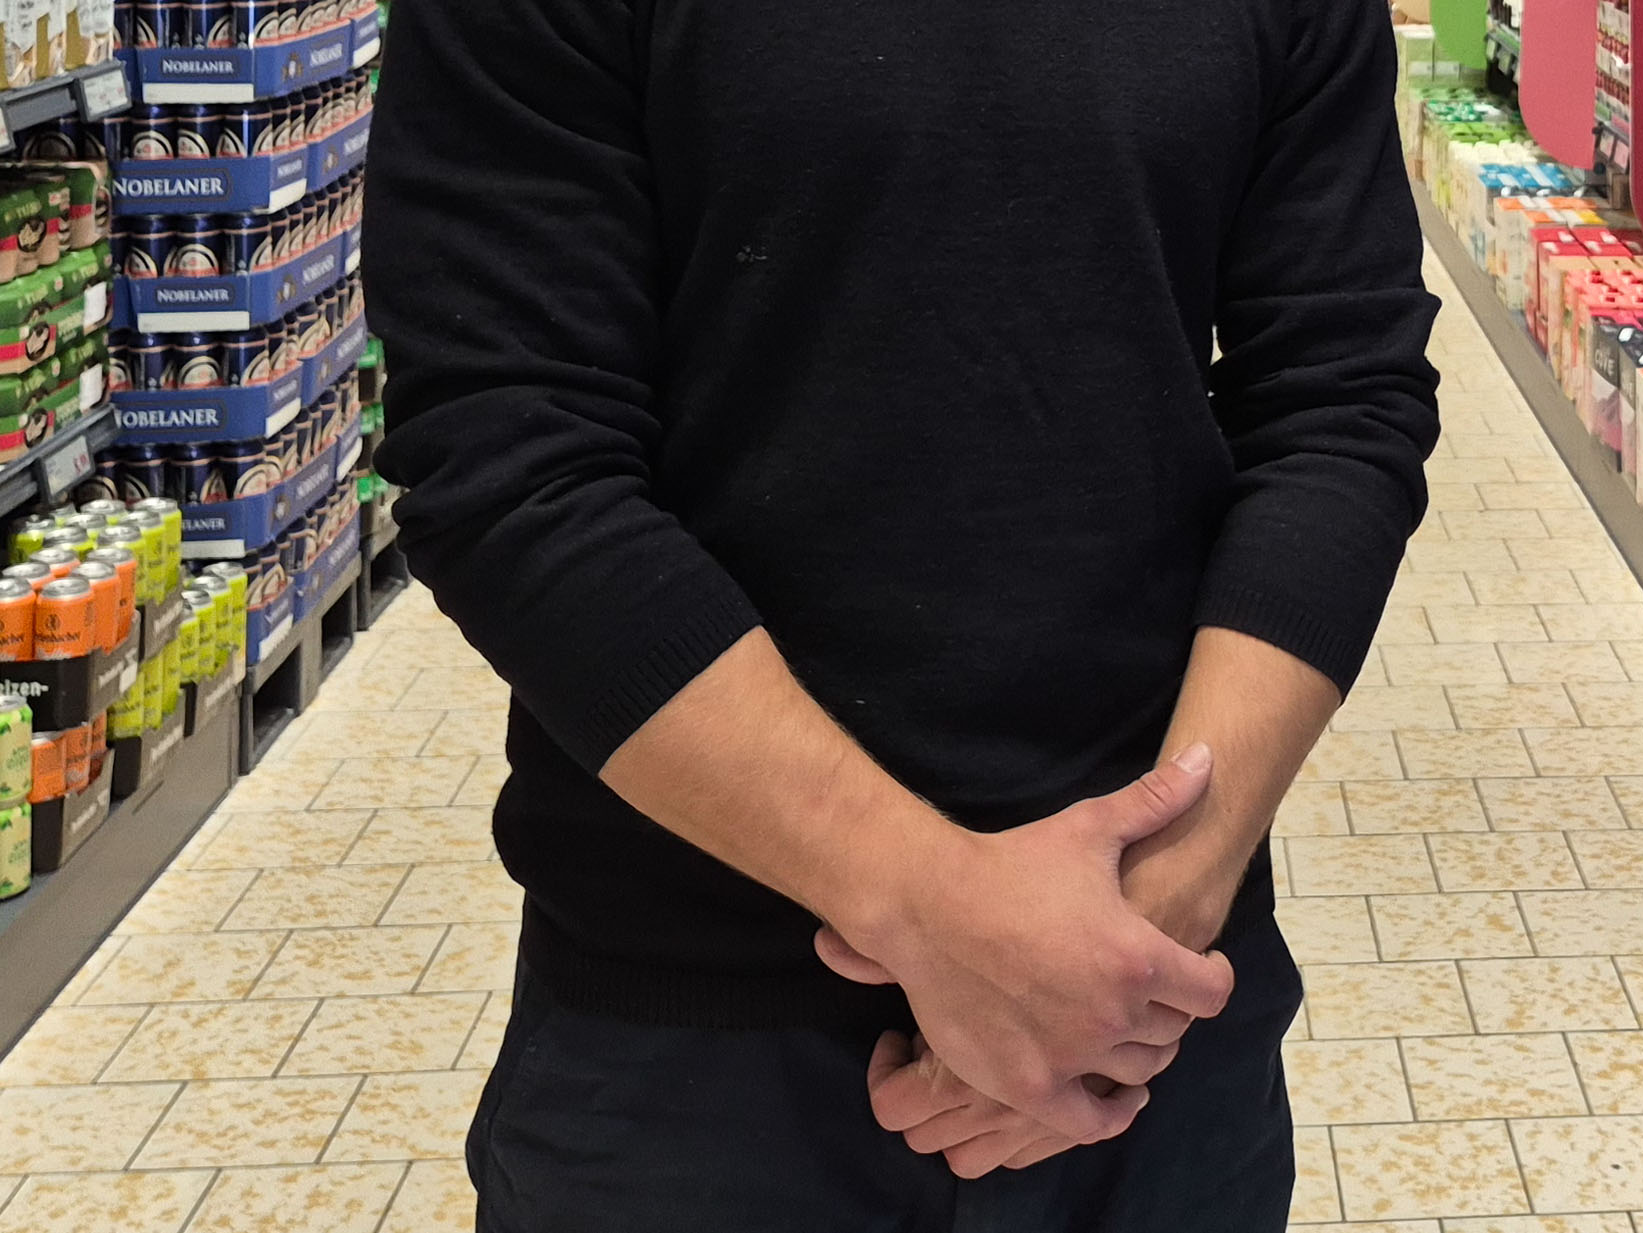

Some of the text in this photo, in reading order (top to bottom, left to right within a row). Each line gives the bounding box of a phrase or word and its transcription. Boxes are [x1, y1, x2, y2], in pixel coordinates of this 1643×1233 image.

[161, 58, 234, 75] NOBELANER
[113, 177, 225, 197] NOBELANER
[157, 288, 230, 304] NOBELANER
